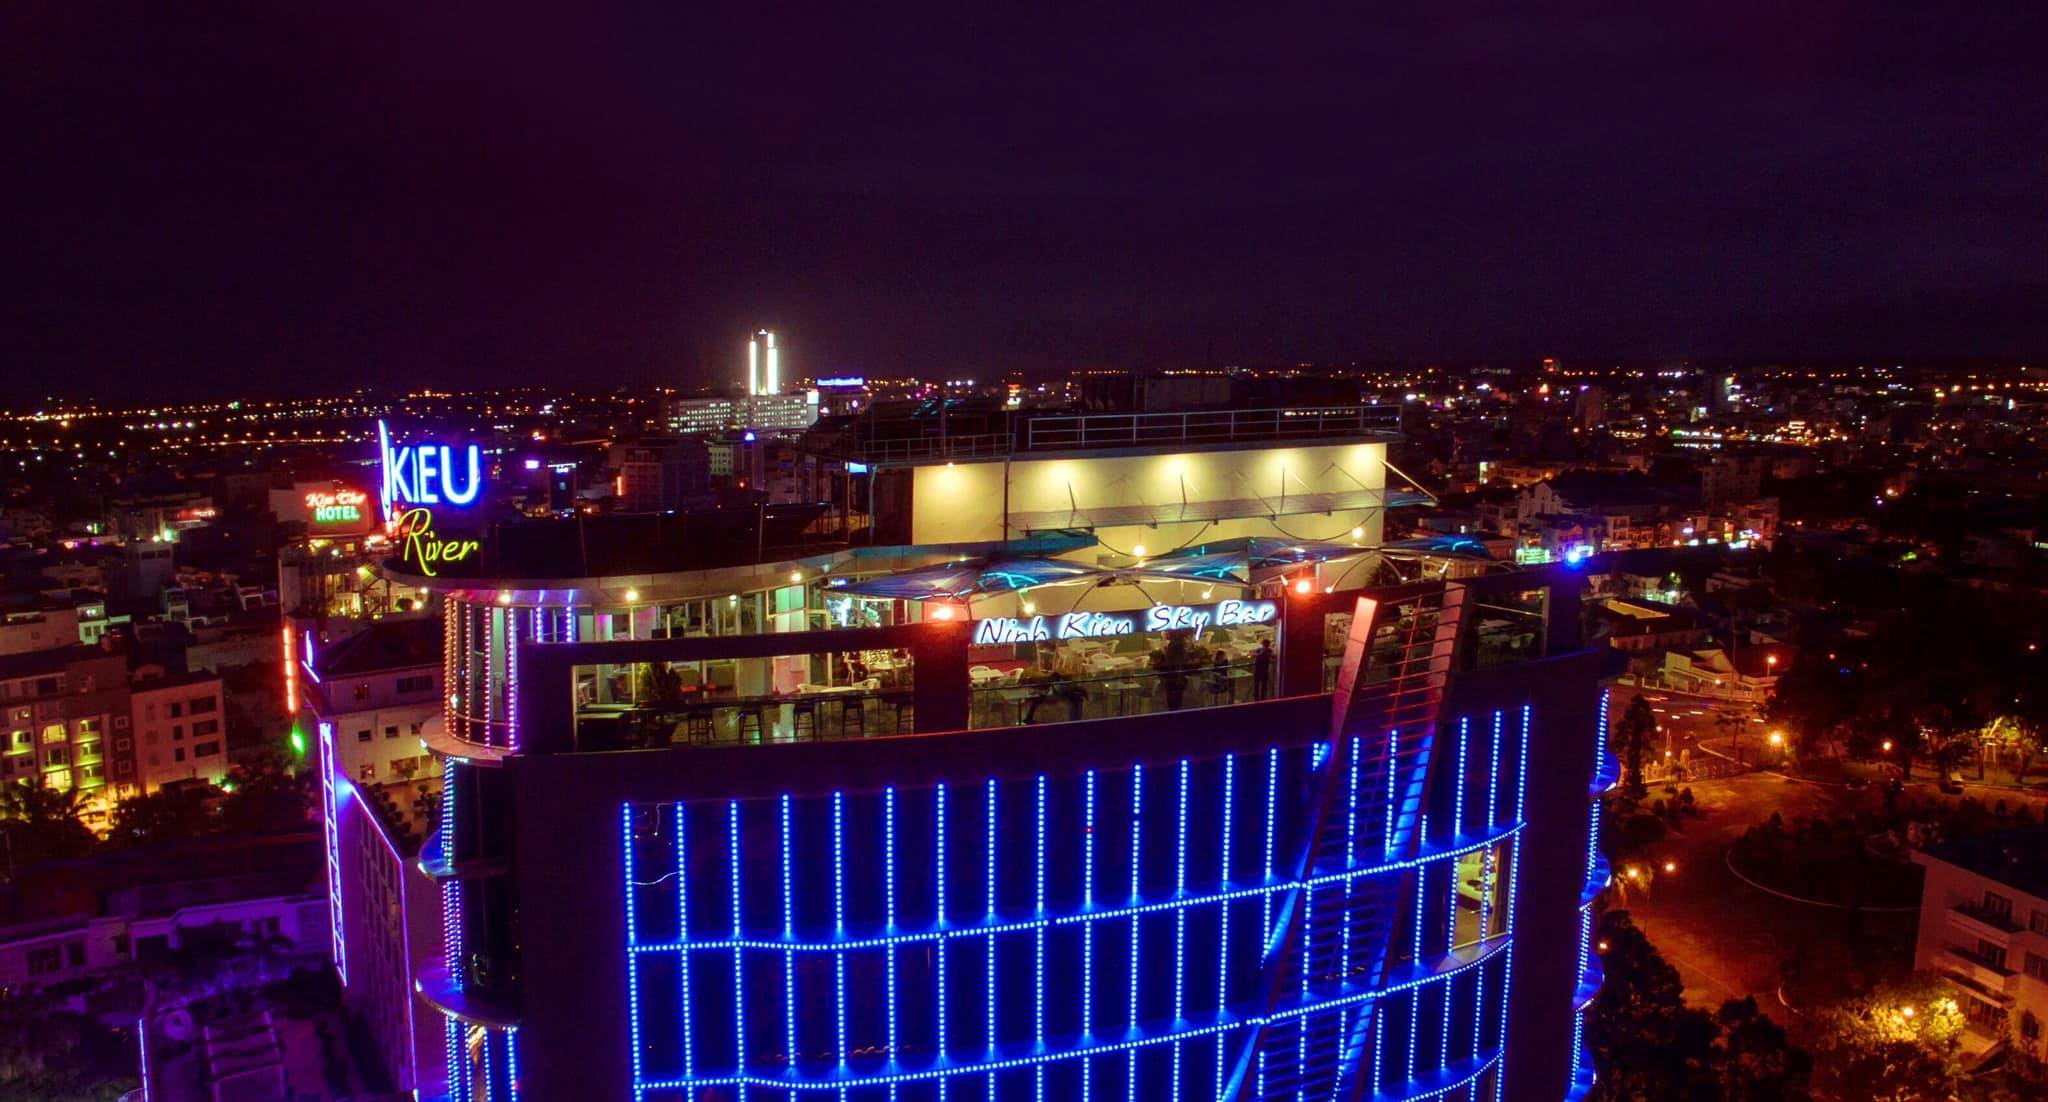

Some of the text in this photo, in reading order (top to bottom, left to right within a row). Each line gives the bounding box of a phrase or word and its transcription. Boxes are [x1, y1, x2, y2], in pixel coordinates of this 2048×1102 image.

[316, 506, 361, 522] HOTEL
[399, 508, 479, 577] River
[977, 616, 1049, 643] Ninh
[1218, 600, 1275, 625] Bar
